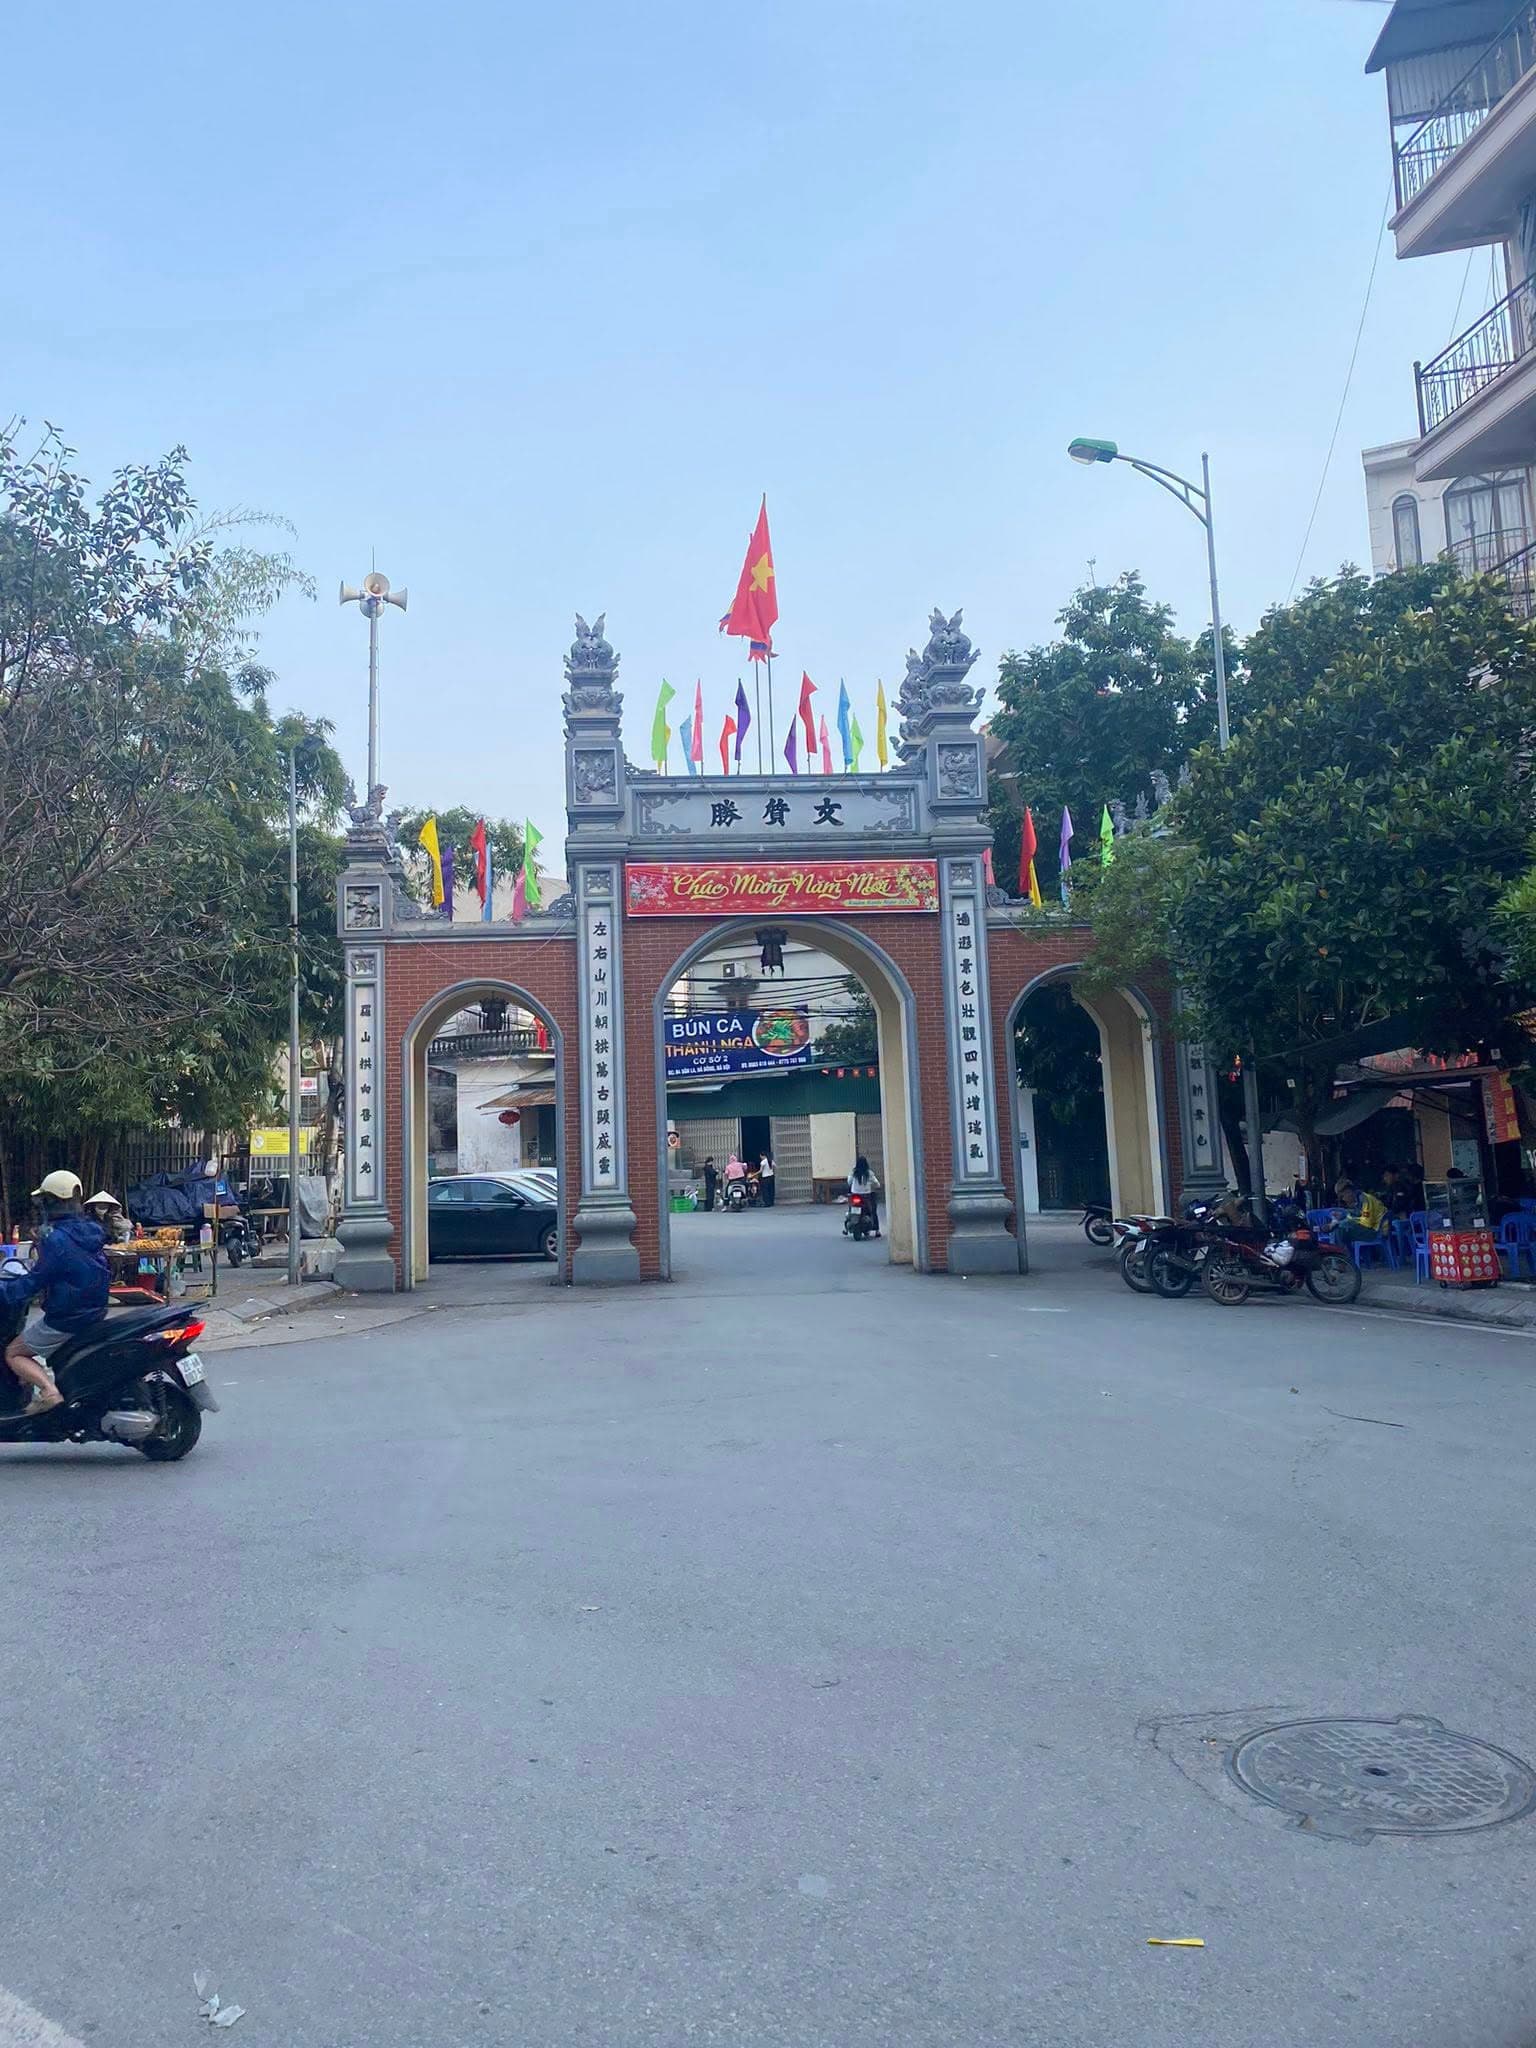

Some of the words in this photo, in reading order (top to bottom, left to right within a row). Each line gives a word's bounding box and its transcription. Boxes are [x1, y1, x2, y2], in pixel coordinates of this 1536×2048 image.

[673, 871, 729, 900] Chúc
[730, 874, 791, 906] Mừng
[792, 873, 841, 899] Năm
[837, 873, 900, 897] Mới
[672, 1019, 711, 1038] BÚN
[720, 1036, 754, 1051] NGA
